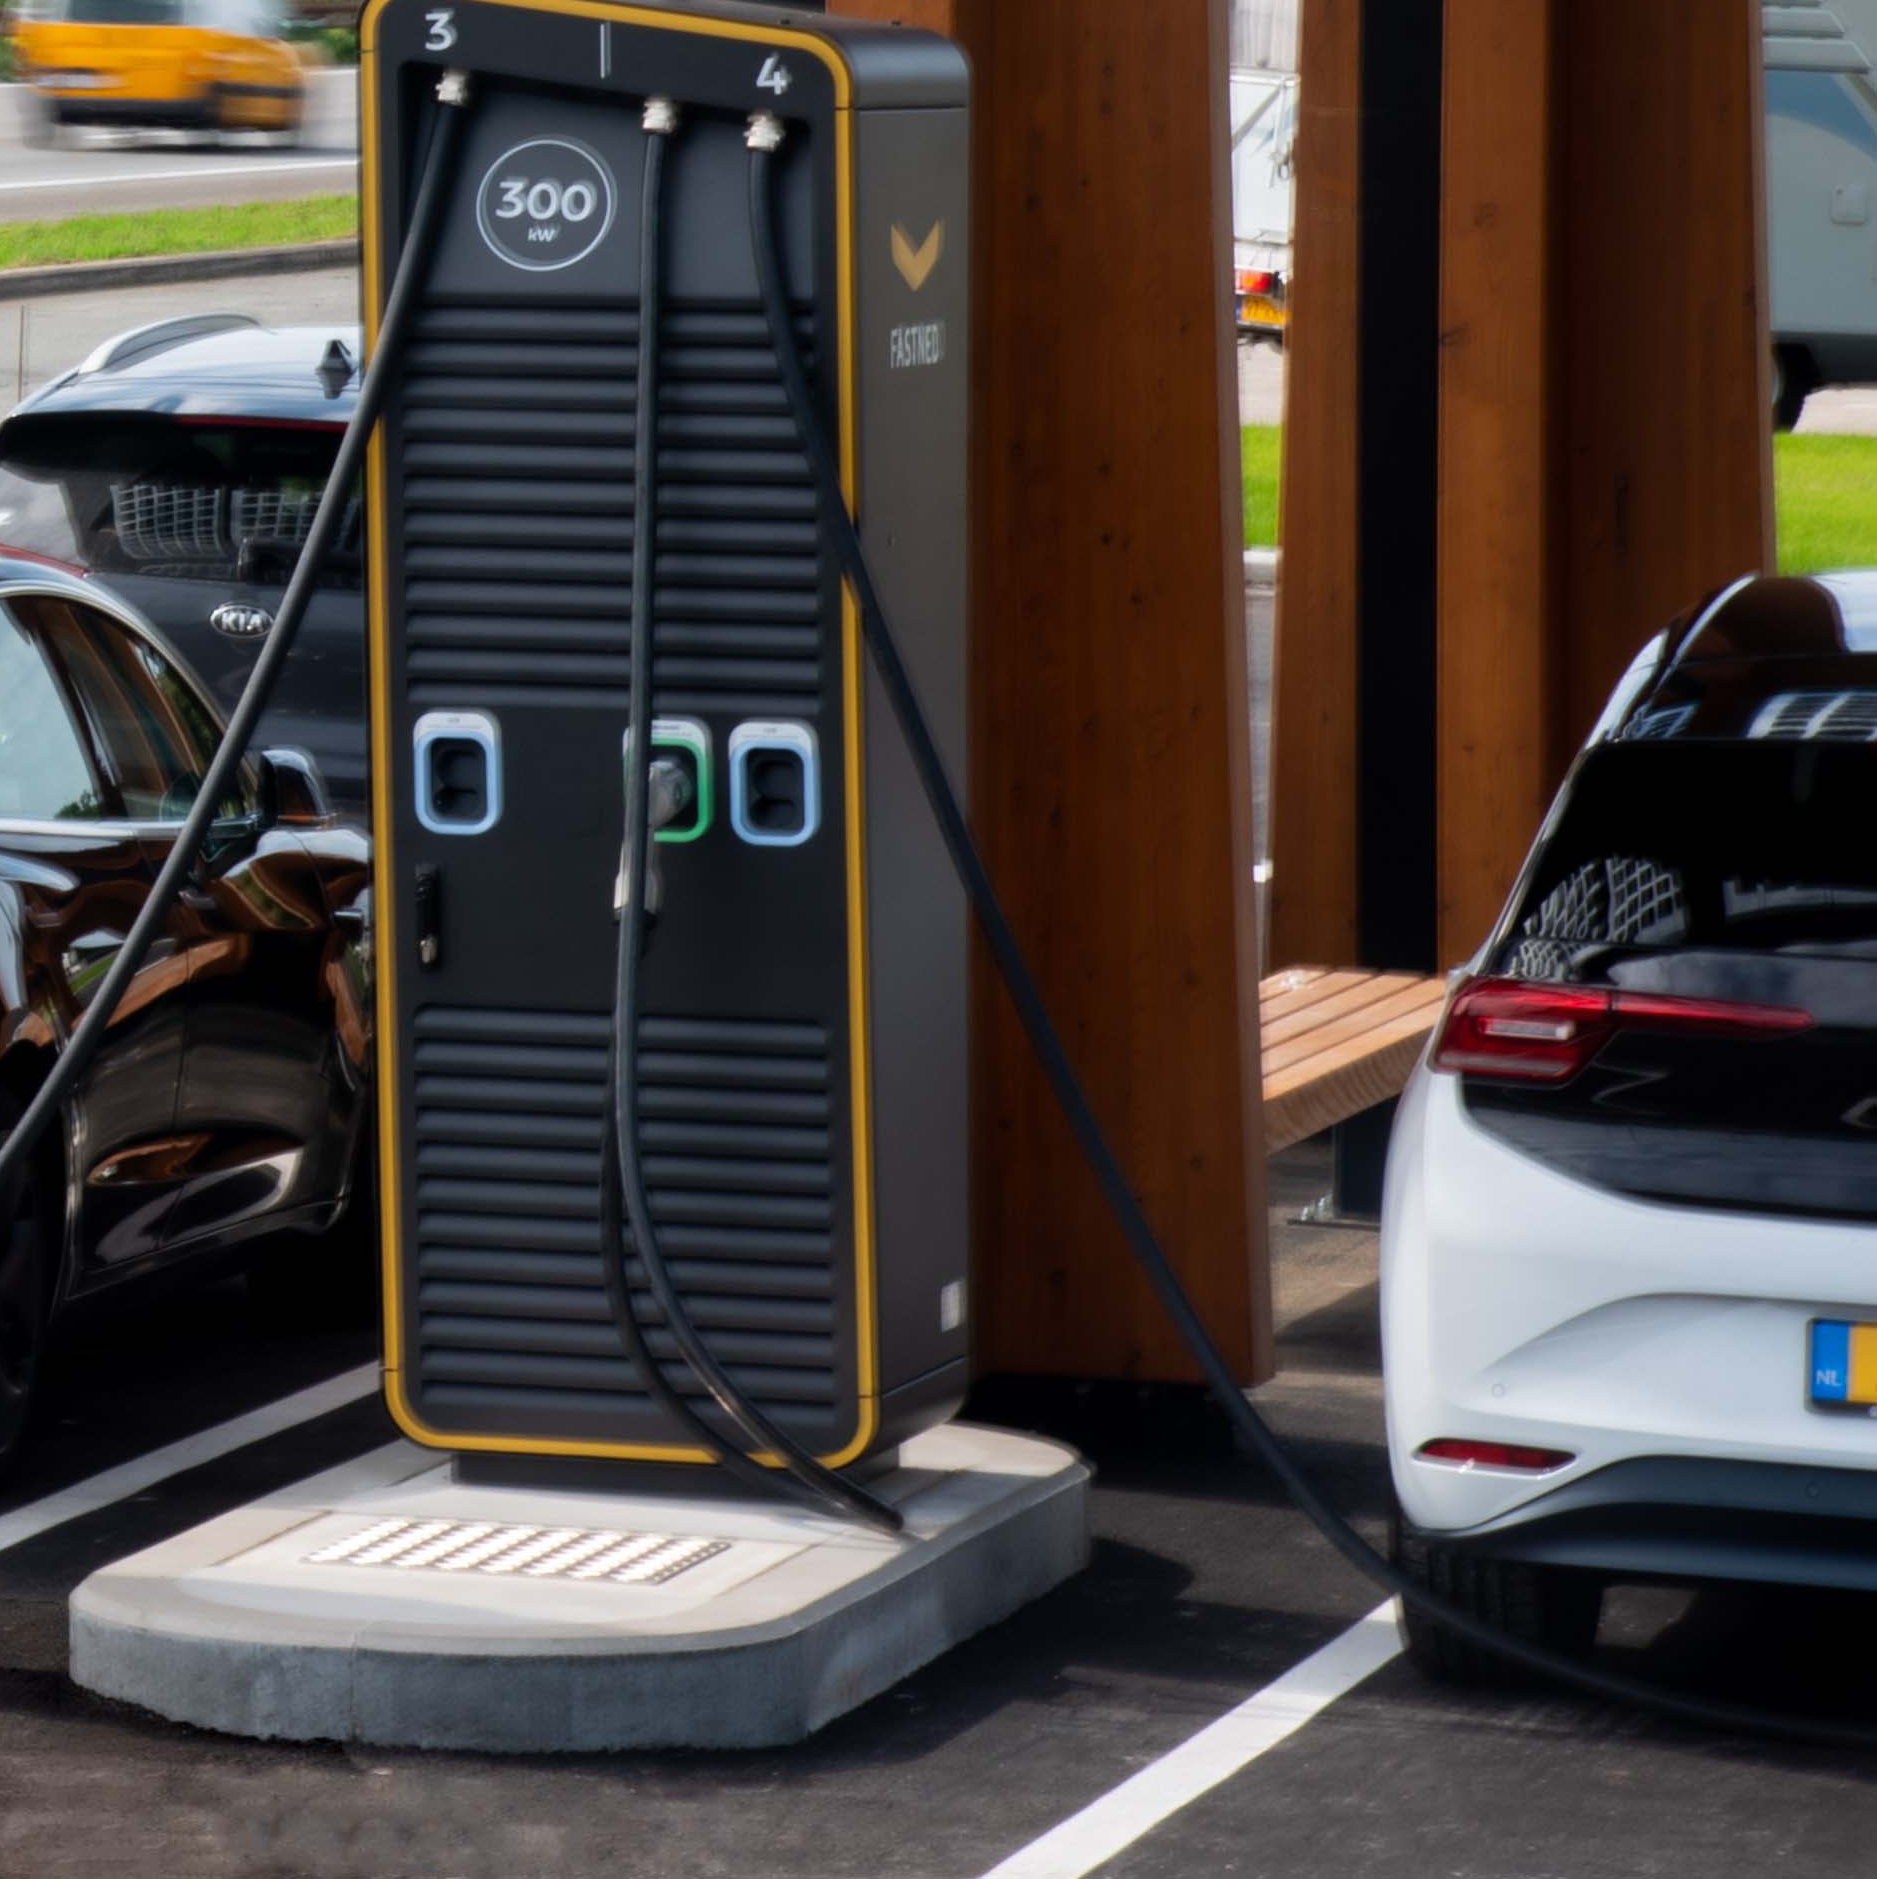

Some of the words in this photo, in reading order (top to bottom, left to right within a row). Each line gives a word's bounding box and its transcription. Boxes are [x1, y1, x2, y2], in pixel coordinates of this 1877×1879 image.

[425, 9, 454, 51] 3
[756, 55, 790, 95] 4
[495, 180, 594, 222] 300
[528, 227, 557, 242] kW
[889, 323, 941, 369] FASTNED
[221, 611, 264, 633] KIA
[1816, 1369, 1842, 1386] NL
